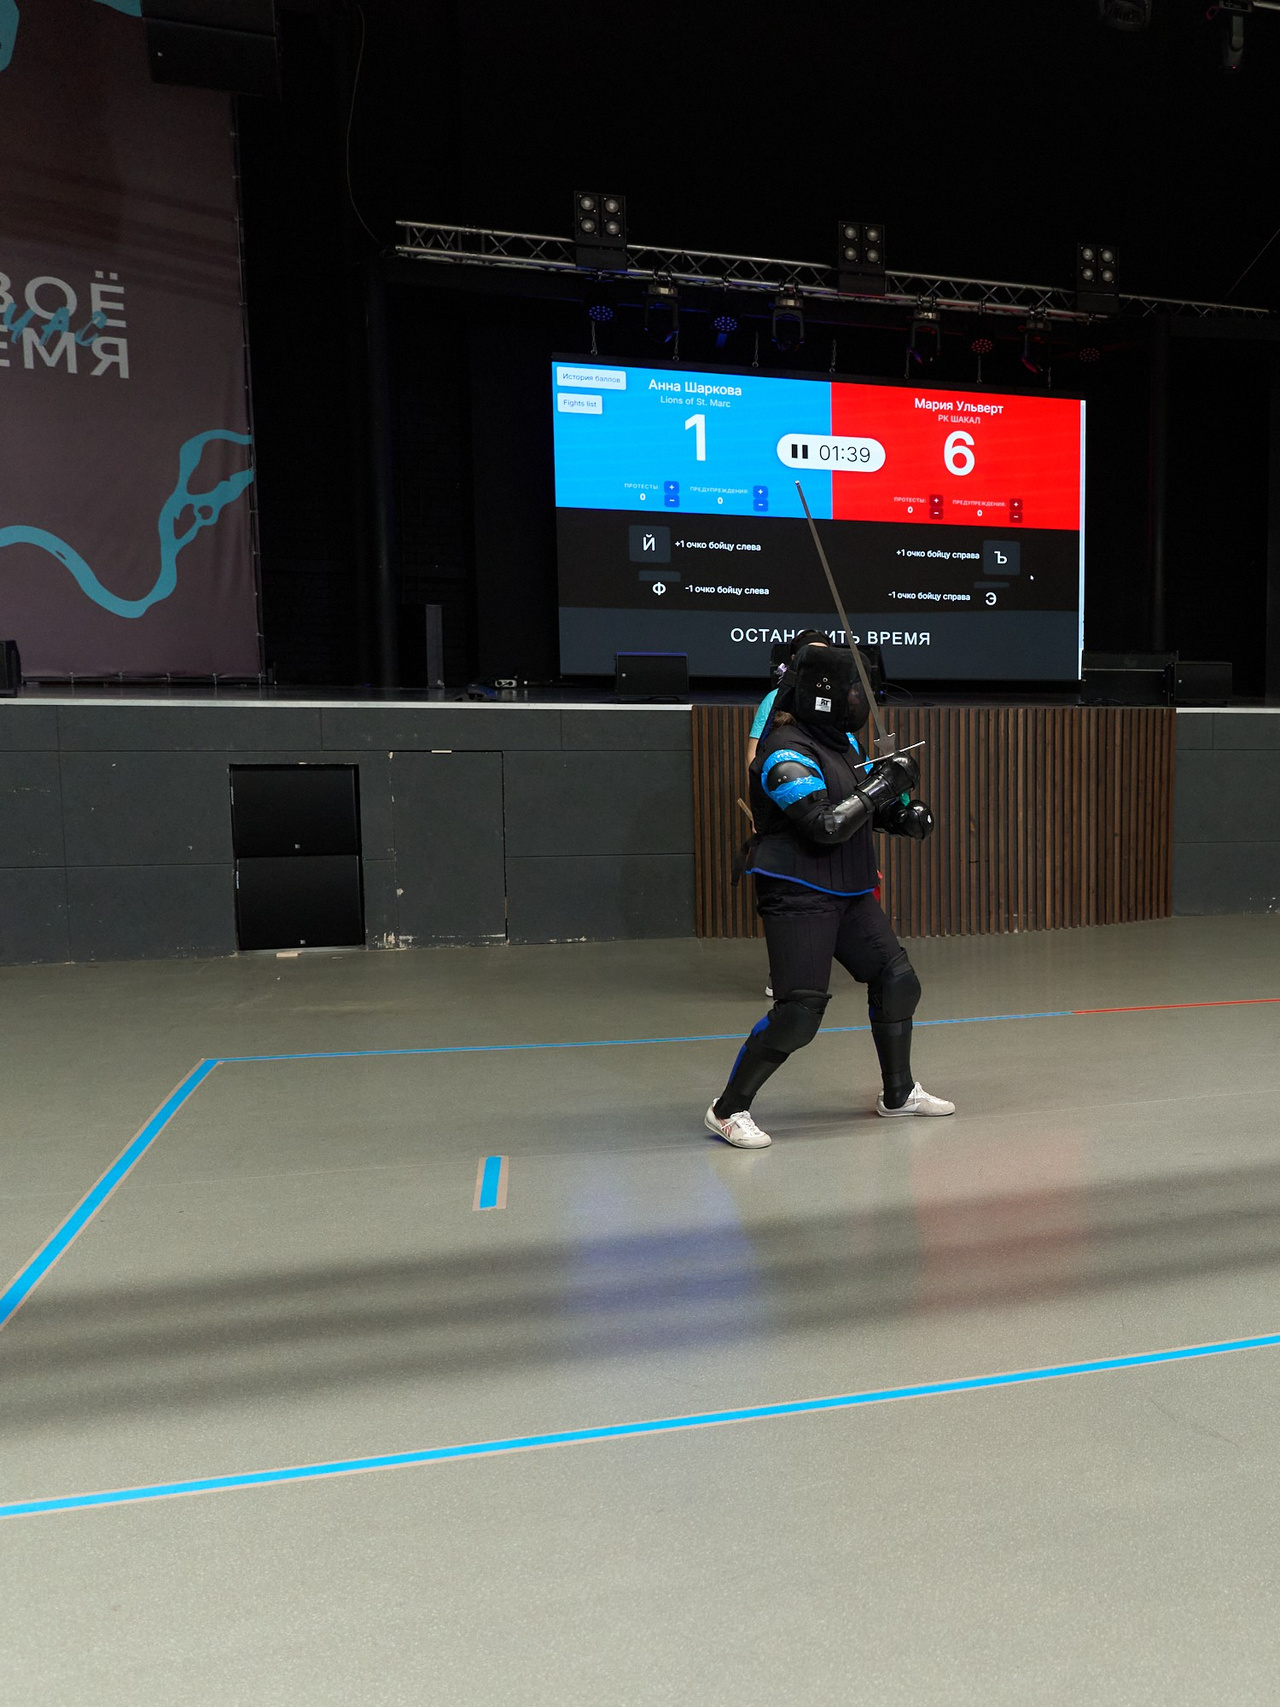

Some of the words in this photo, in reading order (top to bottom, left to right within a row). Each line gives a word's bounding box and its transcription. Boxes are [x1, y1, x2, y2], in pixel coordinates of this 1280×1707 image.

[0, 325, 130, 379] МЯ
[562, 373, 593, 382] История
[595, 375, 621, 384] баллов
[648, 378, 681, 392] Анна
[684, 381, 742, 396] Шаркова
[563, 399, 584, 409] Fights
[586, 400, 597, 408] list
[660, 395, 683, 405] Lions
[686, 397, 695, 405] of
[696, 398, 708, 406] St.
[710, 399, 731, 408] Marc
[914, 397, 953, 412] Мария
[956, 401, 1004, 416] Ульверт
[938, 414, 949, 422] РК
[950, 415, 981, 424] ШАКАЛ
[684, 413, 706, 462] 1
[819, 444, 871, 463] 01:39
[943, 430, 975, 476] 6
[639, 493, 646, 501] 0
[717, 497, 724, 505] 0
[907, 506, 914, 514] 0
[977, 509, 983, 517] 0
[642, 533, 656, 551] Й
[675, 540, 685, 548] +1
[686, 541, 707, 549] очко
[708, 541, 735, 551] бойцу
[896, 549, 905, 557] +1
[906, 550, 926, 558] очко
[926, 549, 951, 560] бойцу
[952, 551, 980, 560] справа
[994, 550, 1008, 565] Ъ
[652, 581, 667, 596] Ф
[685, 584, 693, 593] -1
[695, 586, 716, 594] очко
[717, 585, 743, 596] бойцу
[888, 591, 896, 599] -1
[897, 592, 916, 600] очко
[917, 591, 942, 602] бойцу
[942, 593, 971, 602] справа
[985, 591, 997, 606] Э
[730, 627, 860, 645] ОСТАНИТЬ
[867, 630, 931, 646] ВРЕМЯ
